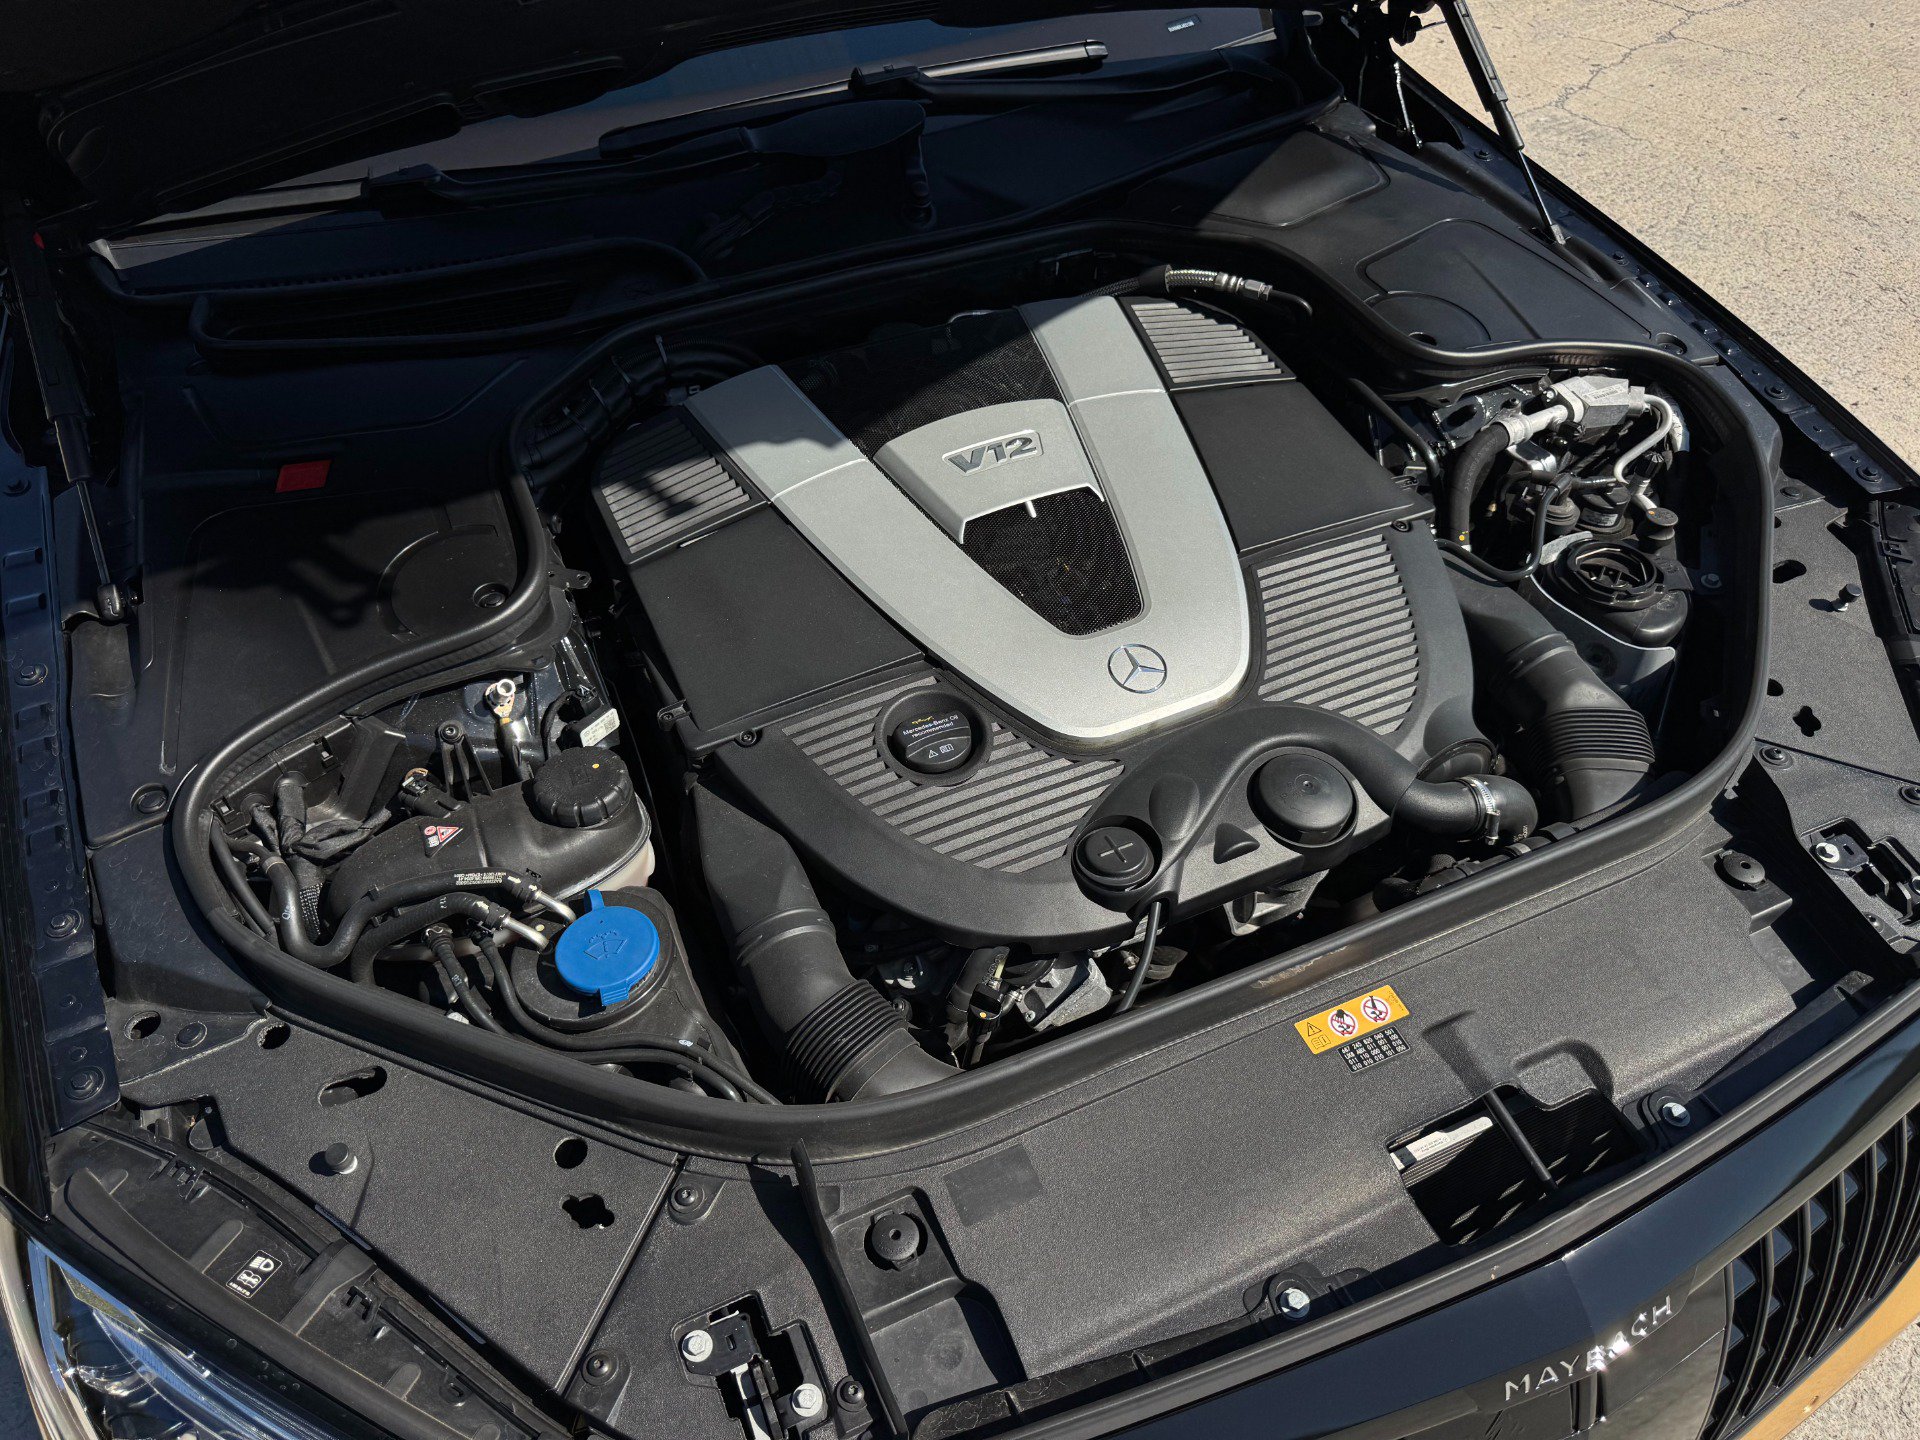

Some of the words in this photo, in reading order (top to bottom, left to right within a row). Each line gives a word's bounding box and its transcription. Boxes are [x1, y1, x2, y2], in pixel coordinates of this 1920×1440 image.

[948, 437, 1037, 473] V12
[903, 719, 949, 735] Mercedes-Benz
[912, 721, 954, 738] recommended
[1505, 1295, 1672, 1401] MAYBACH
